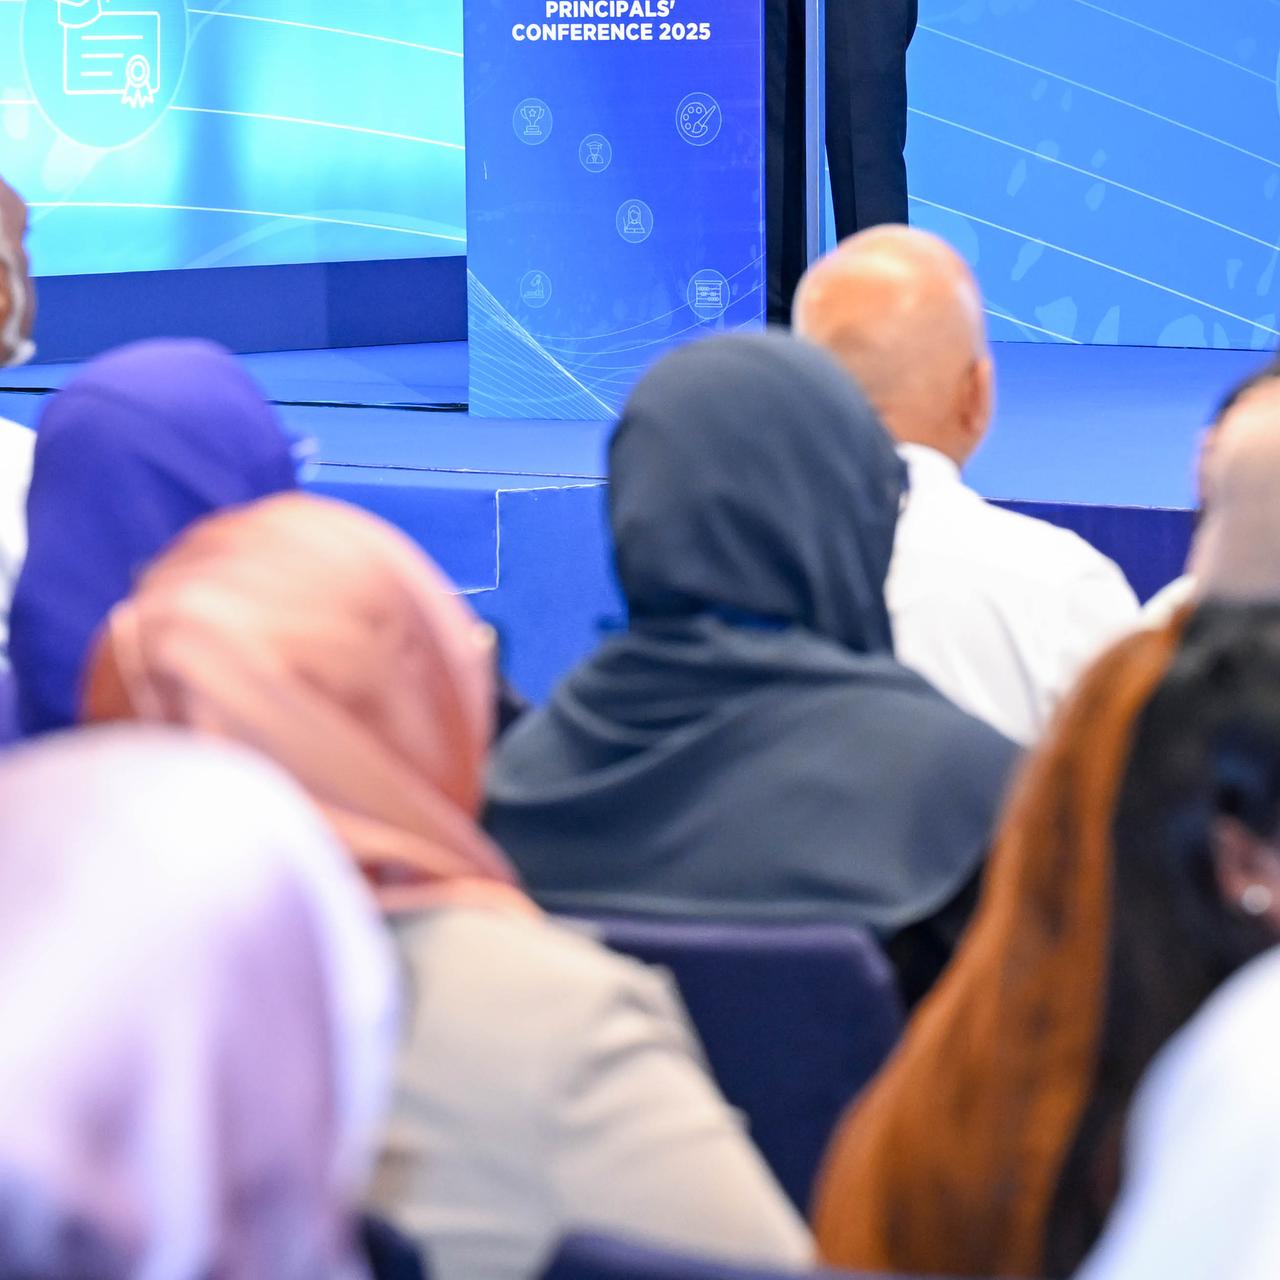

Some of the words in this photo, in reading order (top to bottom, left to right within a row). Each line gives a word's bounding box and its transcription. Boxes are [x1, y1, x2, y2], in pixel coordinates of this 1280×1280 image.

[545, 0, 675, 18] PRINCIPALS'
[511, 22, 653, 41] CONFERENCE
[658, 21, 711, 41] 2025
